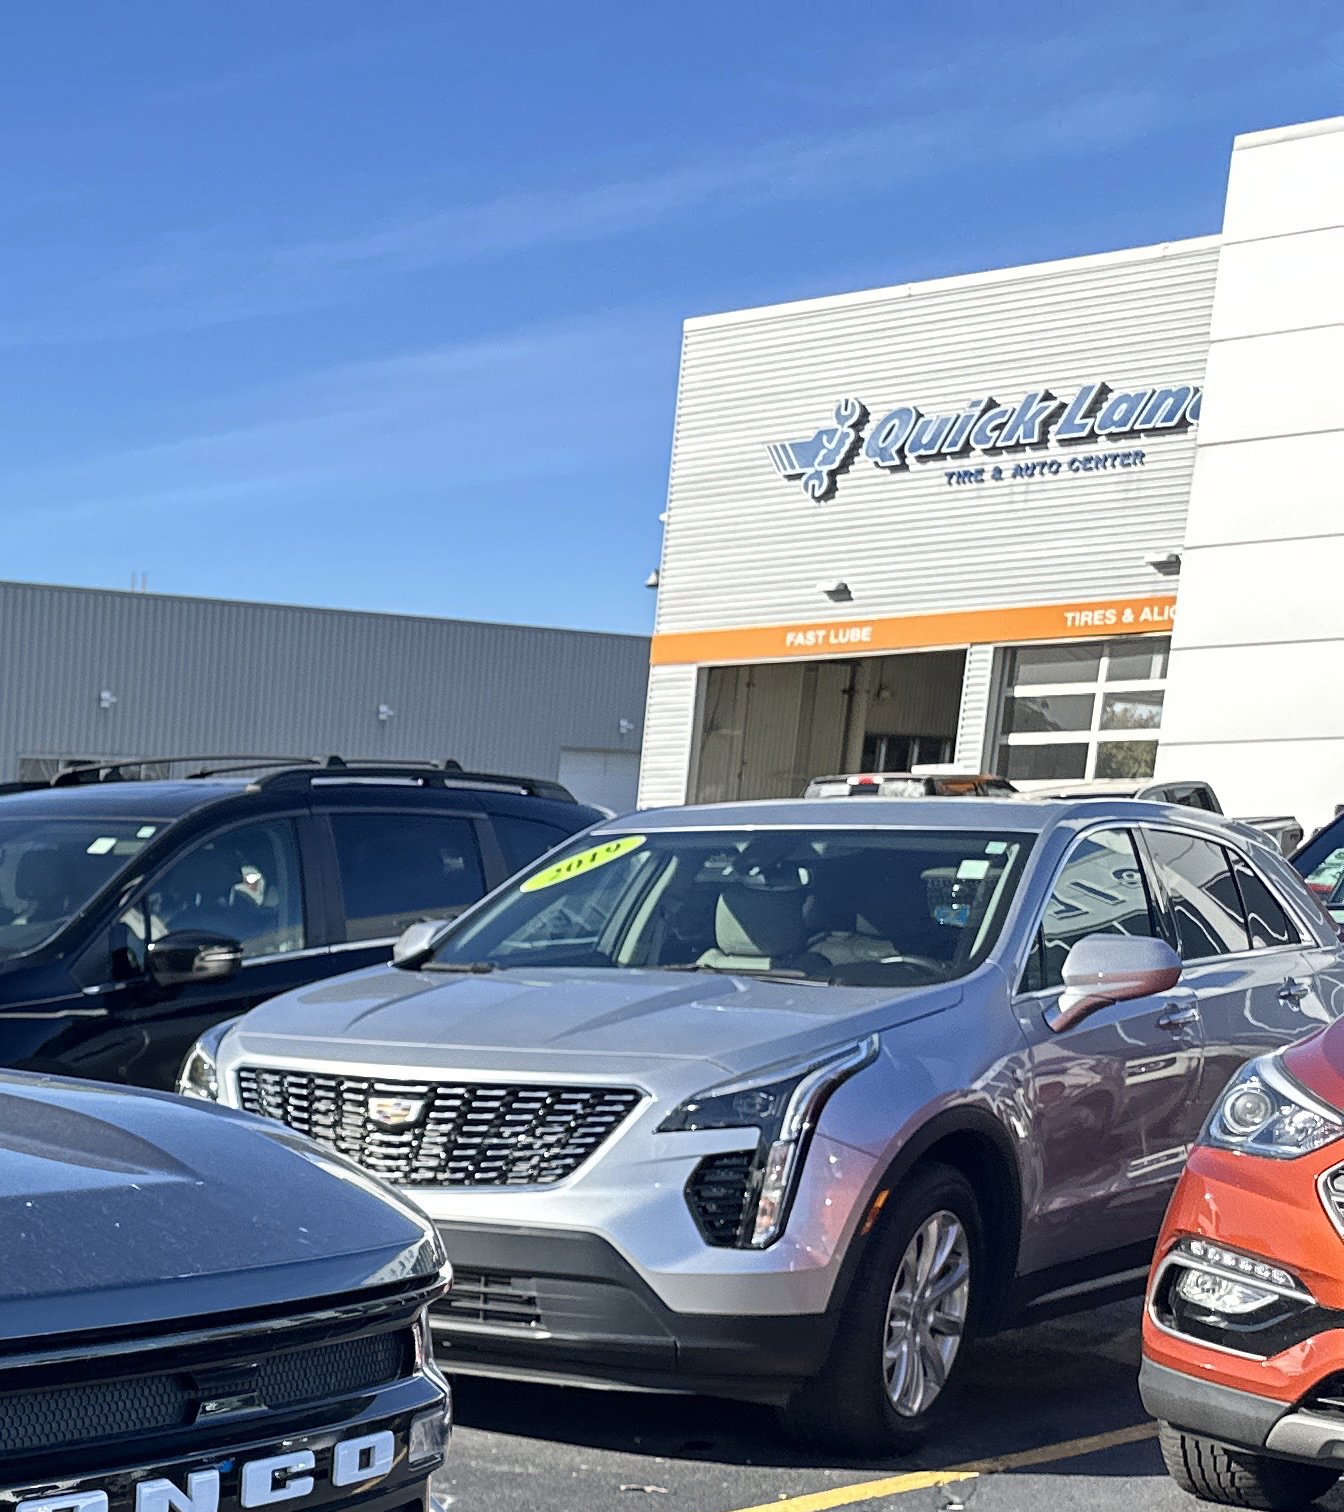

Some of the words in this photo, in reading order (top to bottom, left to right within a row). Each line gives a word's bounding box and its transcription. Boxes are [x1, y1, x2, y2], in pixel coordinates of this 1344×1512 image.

[864, 389, 1062, 467] Quick
[944, 467, 986, 486] TIRE
[991, 465, 1004, 482] &
[1012, 458, 1062, 480] AUTO
[1067, 450, 1146, 473] CENTER
[1063, 608, 1117, 628] TIRES
[1121, 607, 1135, 623] &
[785, 629, 827, 647] FAST
[828, 626, 873, 645] LUBE
